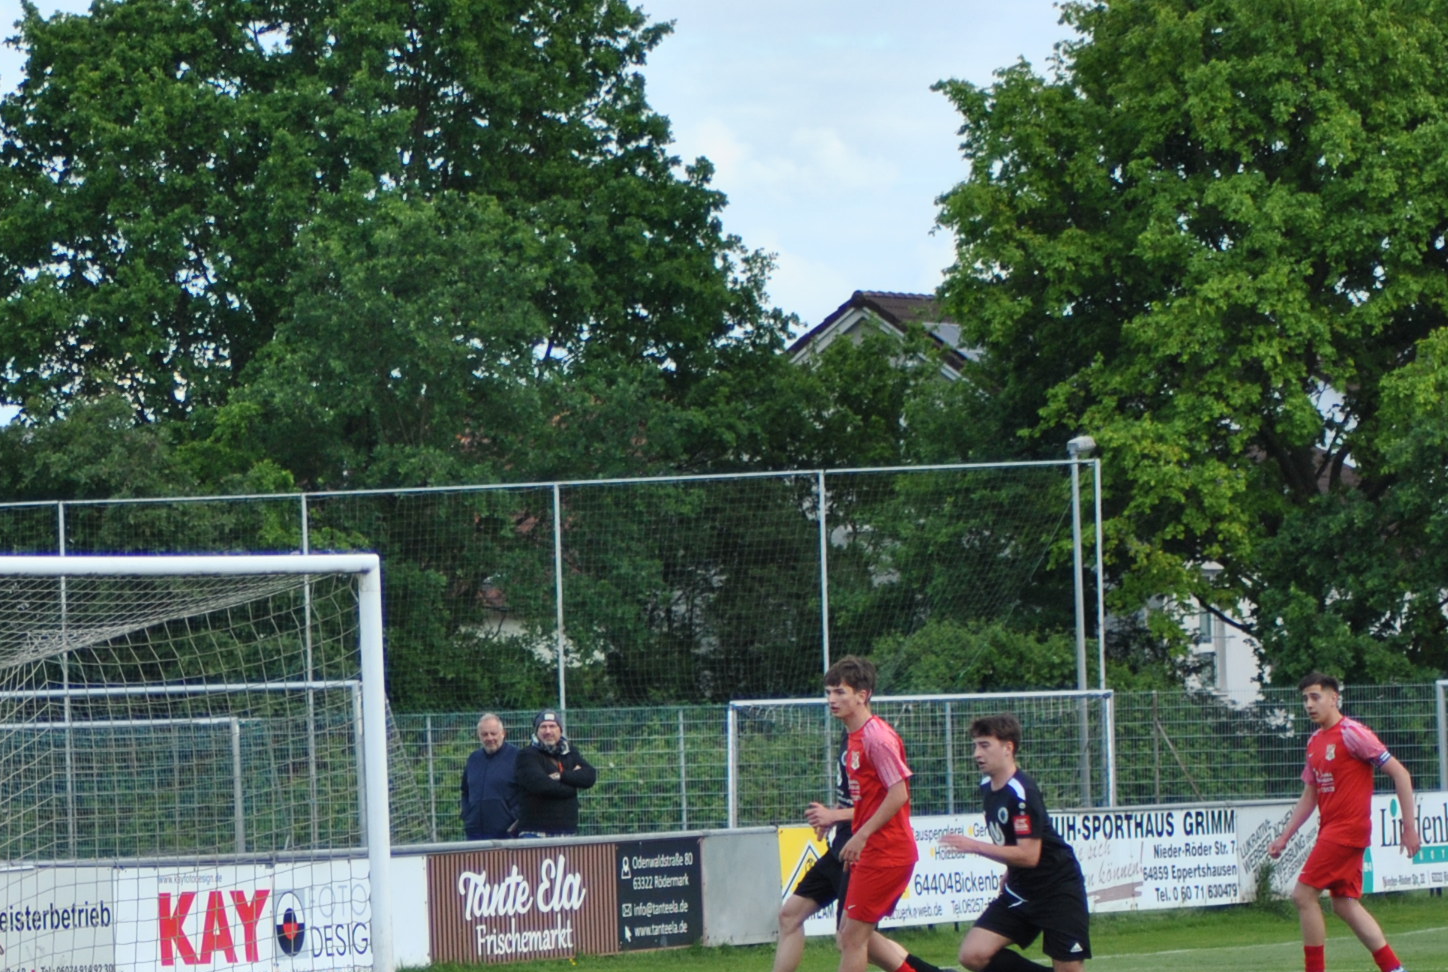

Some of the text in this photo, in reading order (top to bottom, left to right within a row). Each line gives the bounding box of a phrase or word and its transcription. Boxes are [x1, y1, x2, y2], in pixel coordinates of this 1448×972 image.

[1182, 810, 1236, 837] GRIMM
[1380, 799, 1448, 847] Lien
[632, 852, 693, 869] Odenwaldstraße 80
[1153, 840, 1236, 859] Nieder-Röder Str. 7
[633, 873, 689, 890] 63322 Rödermark
[914, 869, 1003, 896] 64404 Bickenb
[1143, 866, 1169, 881] 64859
[1171, 864, 1237, 883] Eppertshausen
[458, 854, 586, 921] Tante Ela
[1155, 883, 1238, 902] Tel. 0 60 71 630479
[309, 884, 368, 919] FOTO
[634, 900, 688, 917] info@tanteela.de
[158, 889, 271, 966] KAY
[310, 922, 373, 958] DESIG
[476, 912, 573, 956] Frischemarkt
[634, 920, 688, 937] www.tanteela.de
